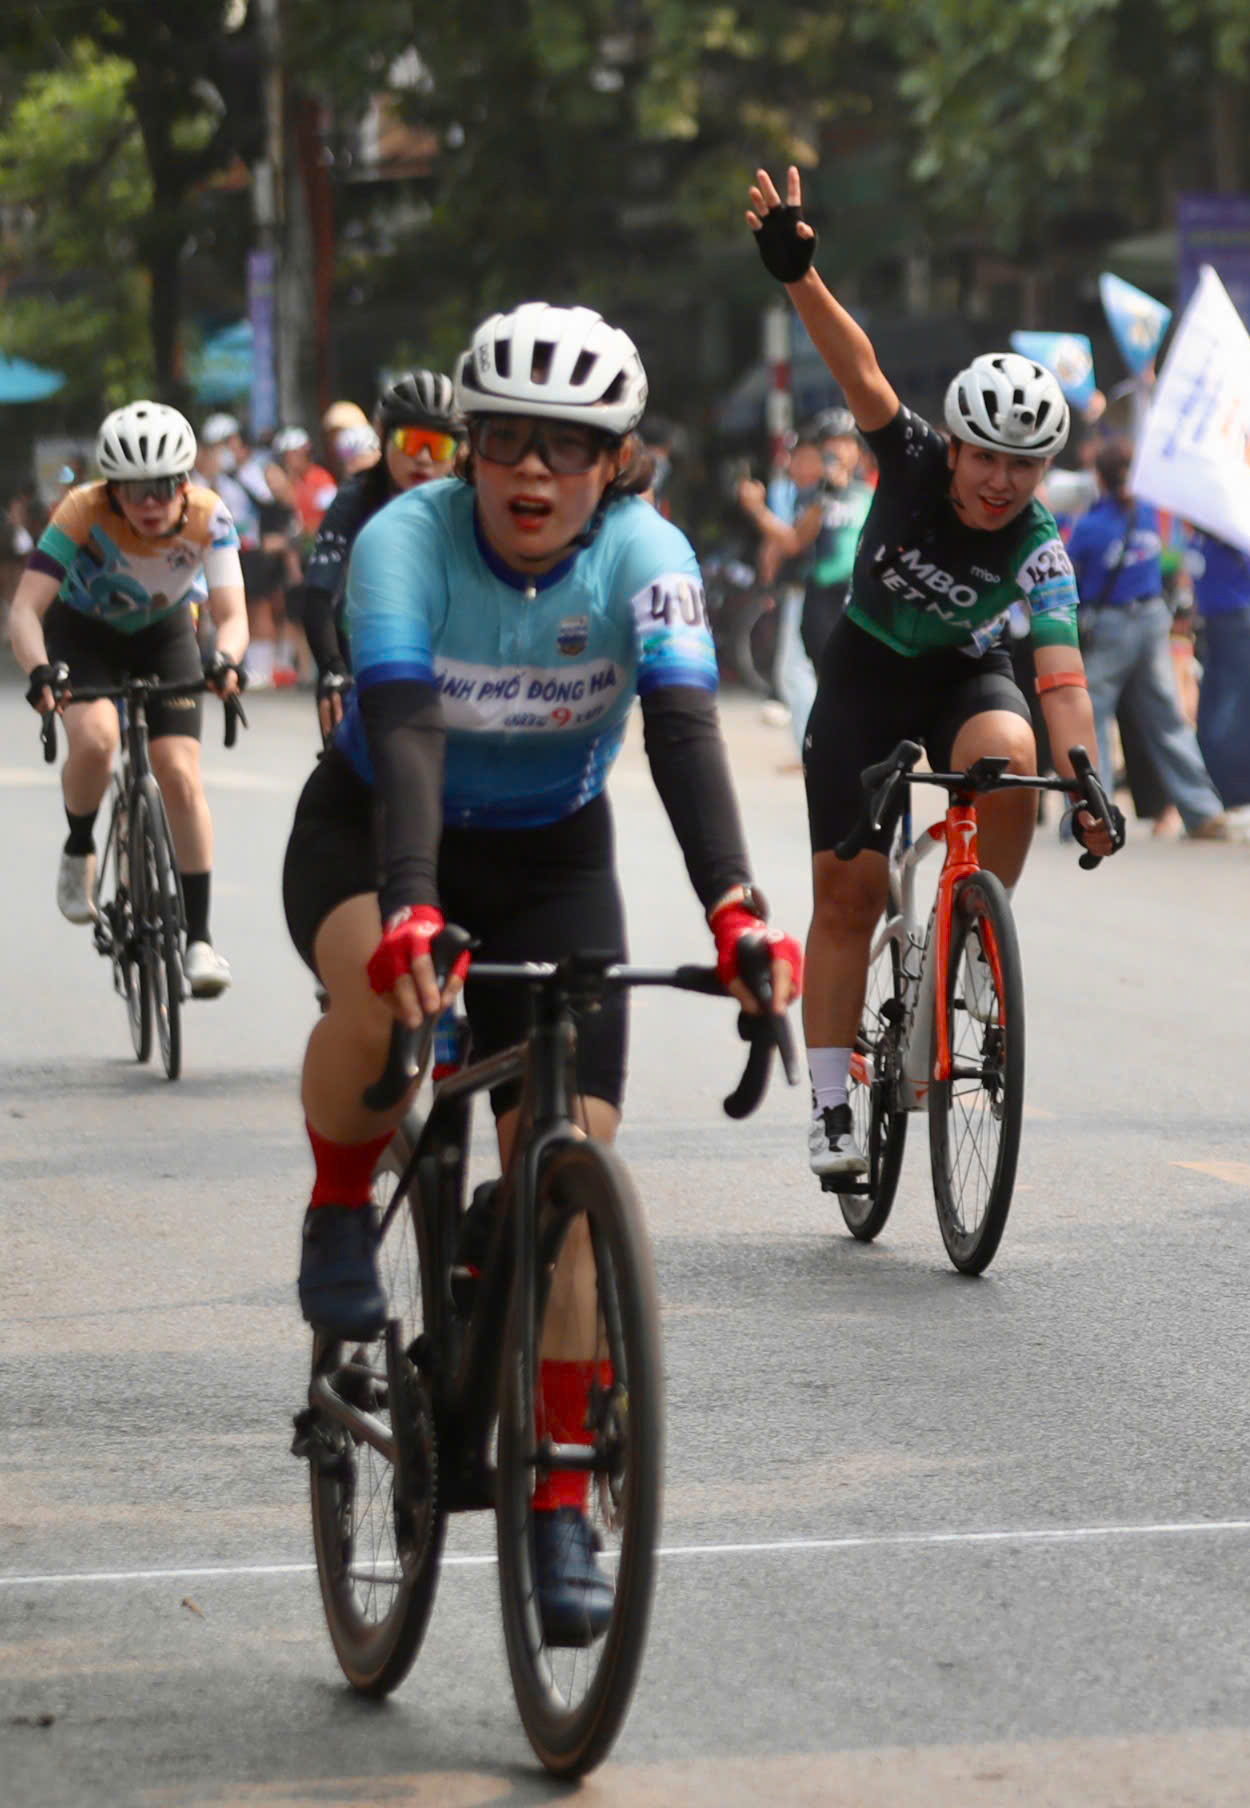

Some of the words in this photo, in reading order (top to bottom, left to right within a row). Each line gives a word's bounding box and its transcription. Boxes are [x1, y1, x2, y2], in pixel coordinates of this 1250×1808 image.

[900, 549, 978, 608] MBO
[969, 564, 1001, 584] mbo
[650, 581, 708, 627] 40
